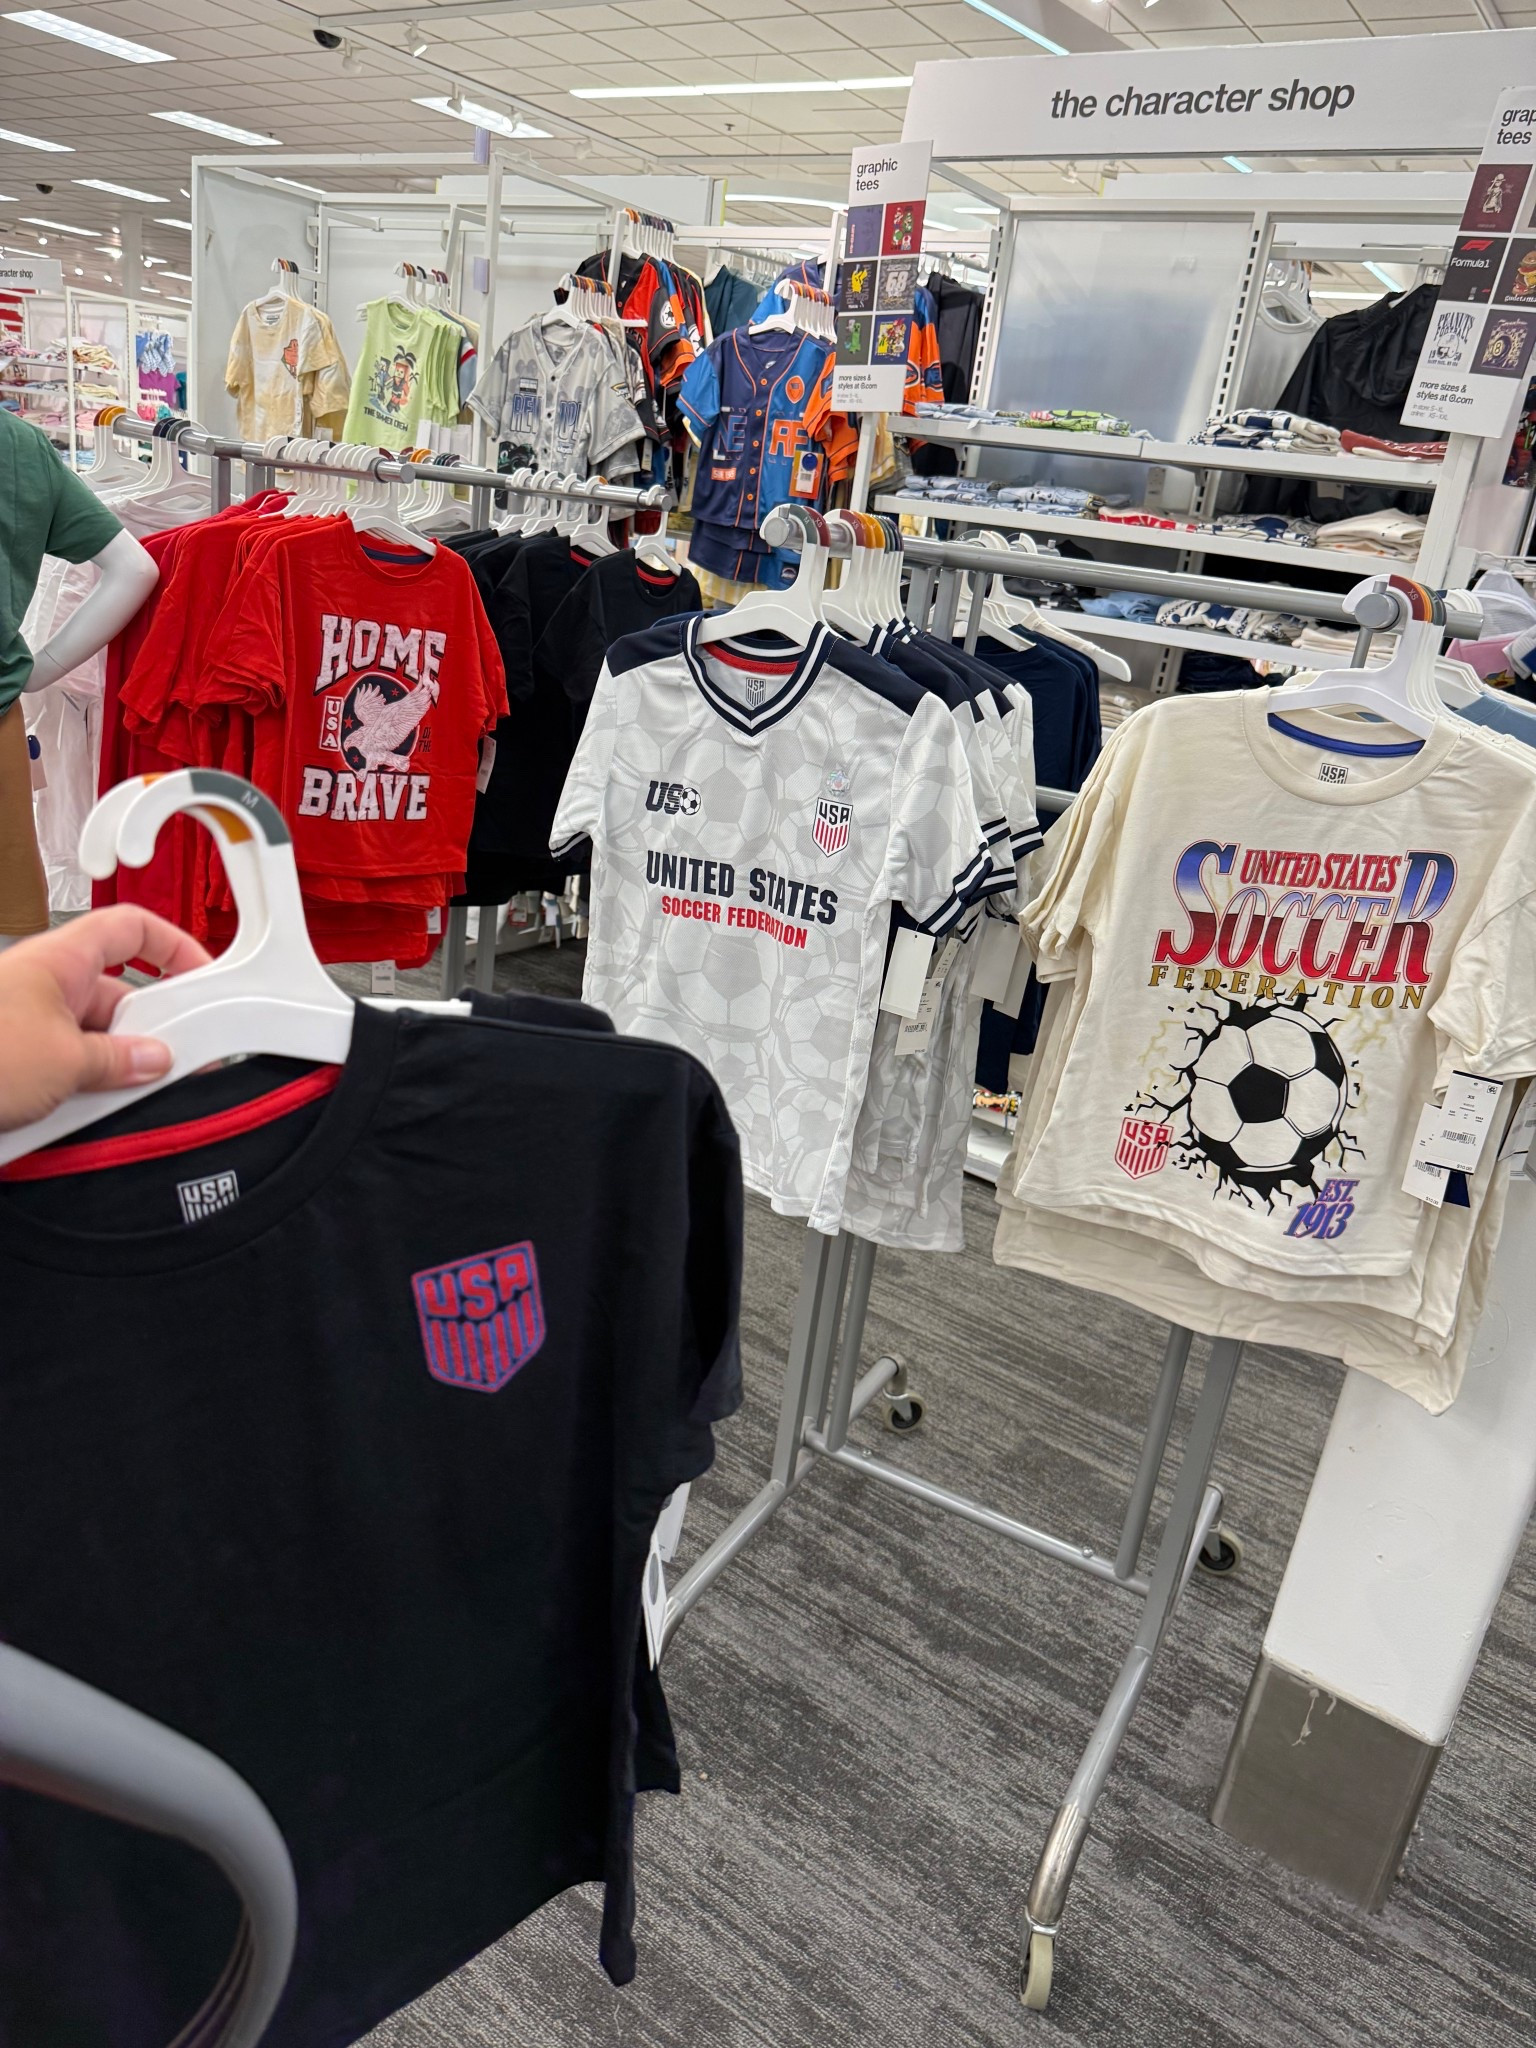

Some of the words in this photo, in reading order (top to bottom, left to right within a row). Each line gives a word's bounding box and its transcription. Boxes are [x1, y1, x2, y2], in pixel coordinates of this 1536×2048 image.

[1050, 89, 1097, 119] the
[1105, 84, 1263, 117] character
[1267, 78, 1355, 118] shop
[1496, 128, 1533, 145] tees
[856, 158, 898, 178] graphic
[856, 179, 879, 191] tees
[19, 268, 34, 280] shop
[837, 382, 853, 391] styles
[853, 374, 867, 382] sizes
[867, 373, 872, 381] &
[1419, 381, 1439, 390] more
[1440, 382, 1459, 393] sizes
[1460, 384, 1467, 393] &
[1416, 390, 1439, 401] styles
[1439, 393, 1447, 402] at
[363, 406, 376, 417] THE
[393, 419, 409, 432] CREW
[803, 516, 811, 525] M
[813, 517, 823, 528] XS
[1407, 588, 1419, 601] XS
[313, 613, 447, 708] HOME
[748, 679, 765, 691] USA
[323, 700, 341, 748] USA
[1322, 764, 1346, 780] USA
[241, 789, 260, 809] M
[298, 765, 431, 822] BRAVE
[819, 801, 850, 826] USA
[1240, 848, 1321, 889] UNITED
[1317, 853, 1402, 893] STATES
[646, 850, 735, 898] UNITED
[749, 867, 838, 925] STATES
[661, 895, 722, 924] SOCCER
[727, 906, 808, 949] FEDERATION
[1152, 838, 1458, 985] SOCCER
[1147, 965, 1427, 1010] FEDERATION
[1125, 1121, 1169, 1147] USA
[183, 1175, 235, 1203] USA
[1318, 1178, 1360, 1203] EST.
[1283, 1202, 1356, 1240] 1913
[422, 1252, 530, 1319] USA
